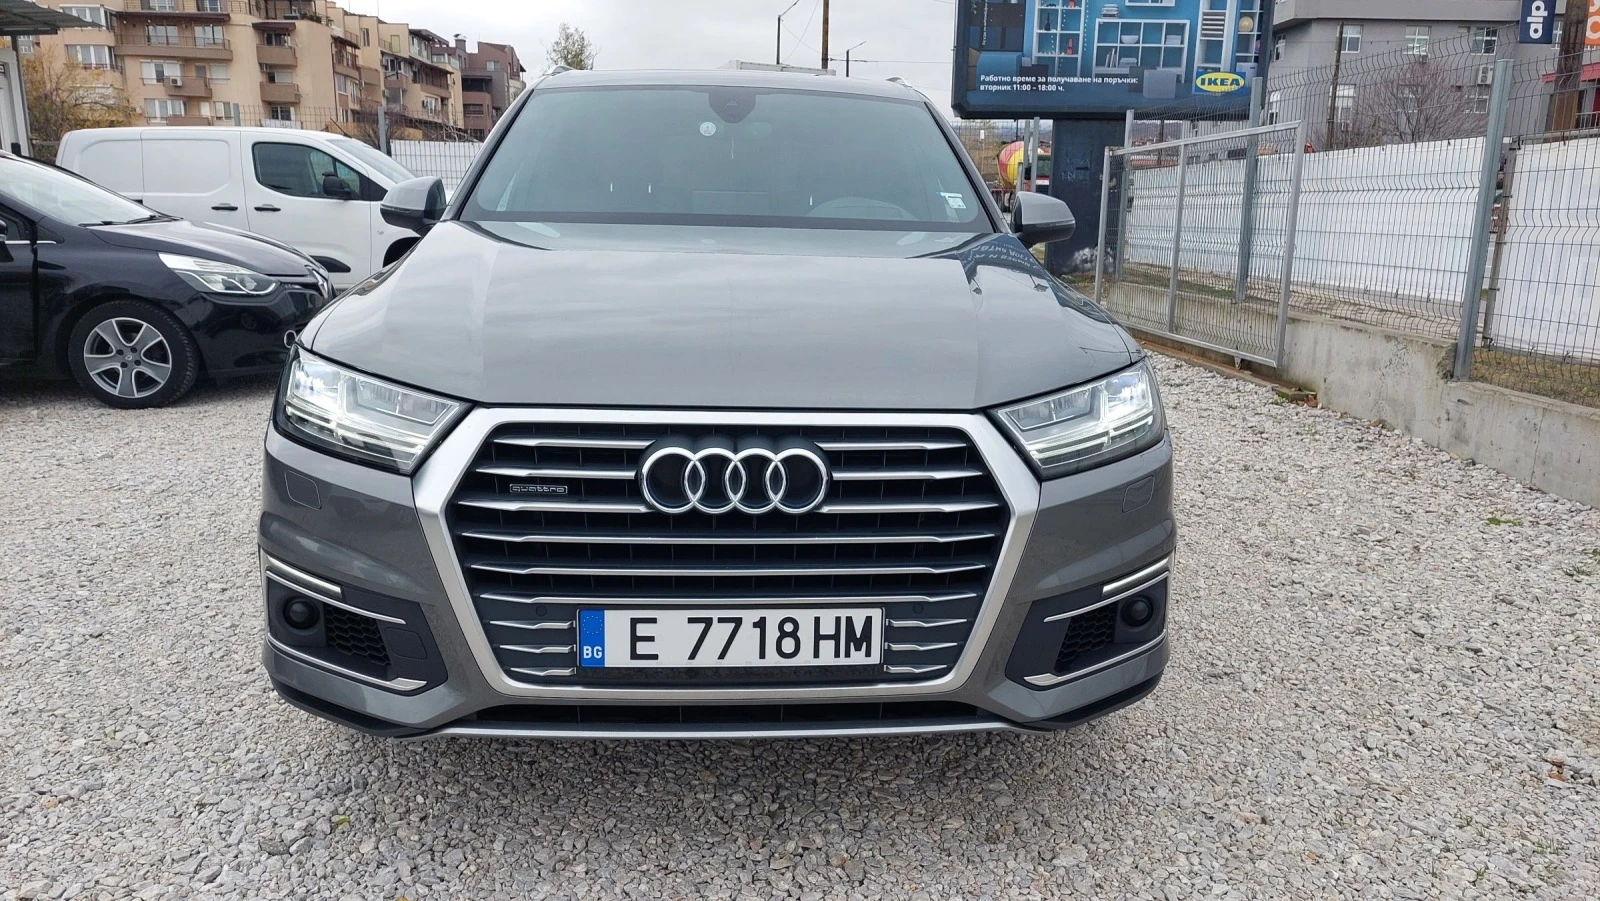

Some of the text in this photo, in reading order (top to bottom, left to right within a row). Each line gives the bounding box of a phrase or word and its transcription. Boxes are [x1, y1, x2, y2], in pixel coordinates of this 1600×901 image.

[980, 74, 1011, 82] Работно
[1012, 76, 1036, 84] време
[1047, 76, 1092, 84] получаване
[1103, 77, 1138, 85] поръчки:
[1200, 77, 1240, 86] IKEA
[980, 84, 1011, 92] вторник
[629, 615, 873, 661] E 7718 HM
[583, 645, 603, 659] BG
